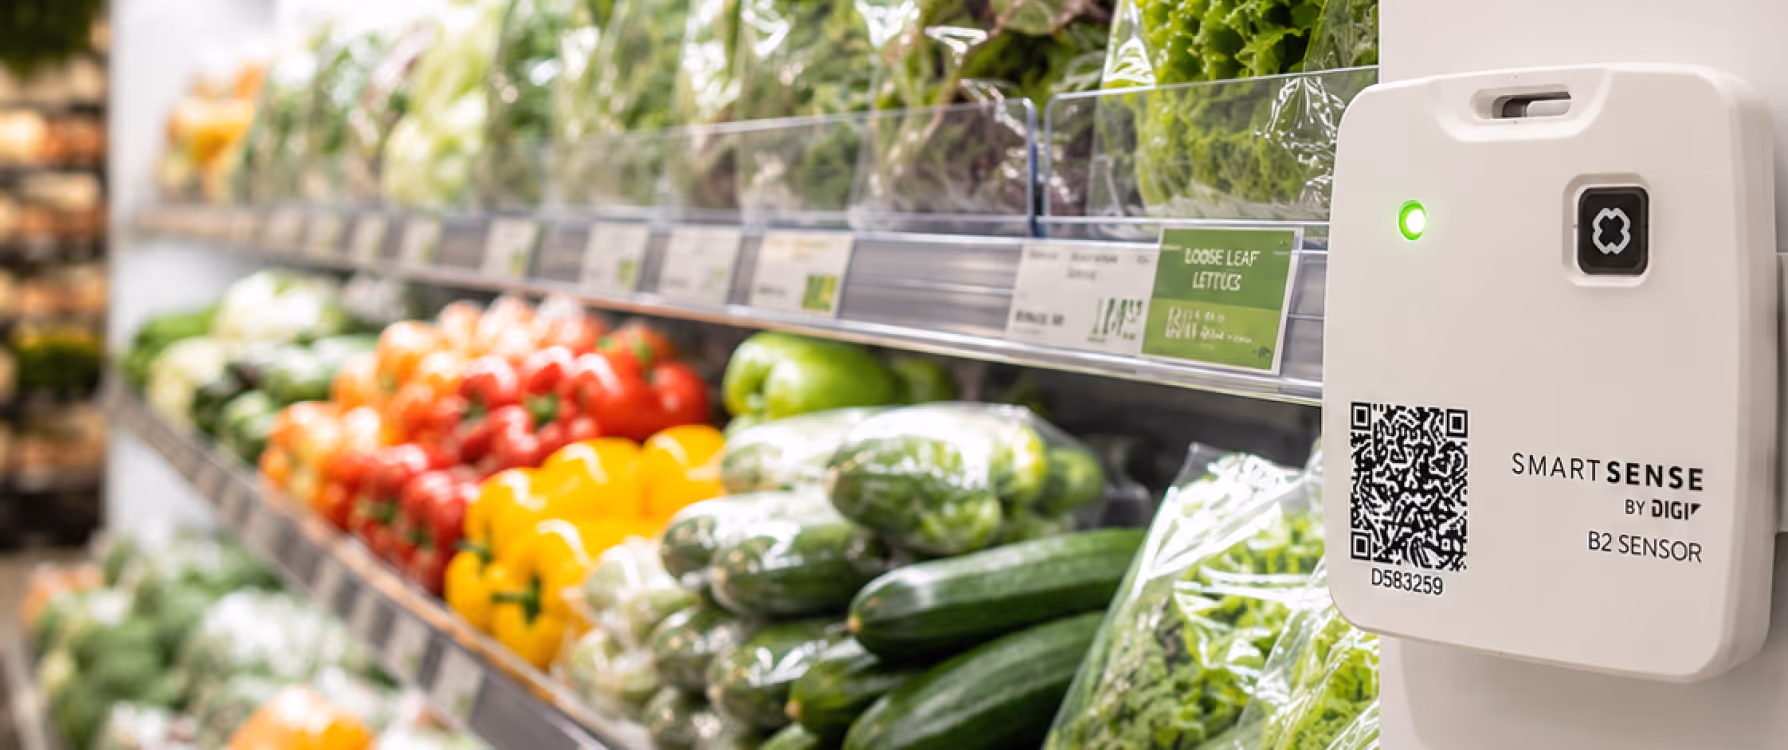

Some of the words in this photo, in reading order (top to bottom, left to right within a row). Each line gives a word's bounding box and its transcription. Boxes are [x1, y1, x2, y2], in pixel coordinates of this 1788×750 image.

[1184, 248, 1224, 266] LOOSE
[1226, 250, 1261, 267] LEAF
[1624, 498, 1646, 516] BY
[1651, 499, 1690, 521] DIGI
[1588, 530, 1613, 553] B2
[1618, 534, 1703, 564] SENSOR
[1371, 567, 1444, 597] D583259
